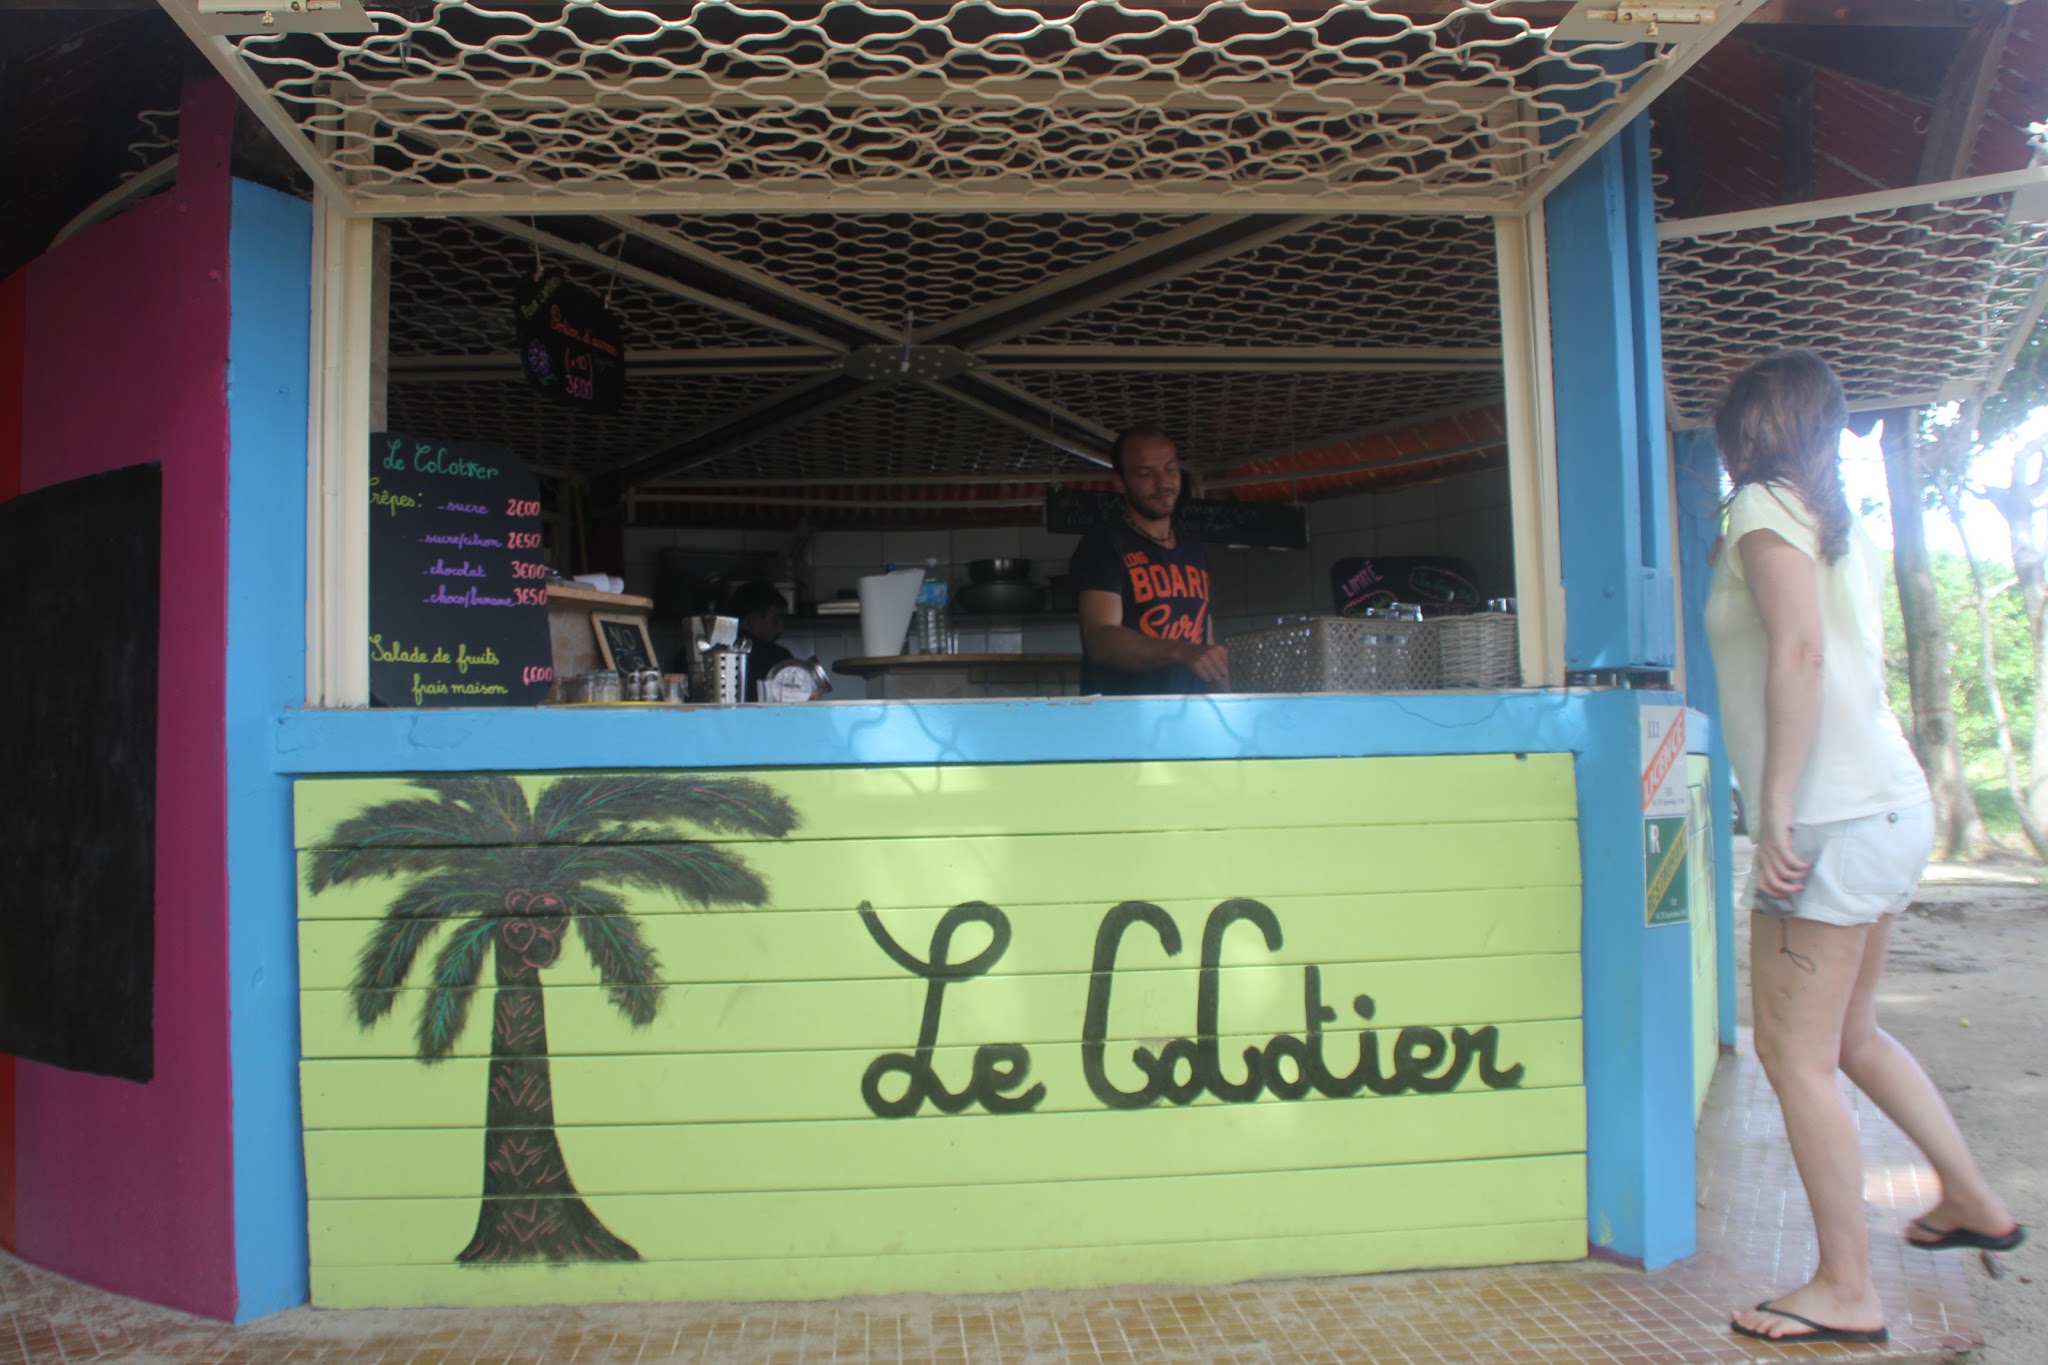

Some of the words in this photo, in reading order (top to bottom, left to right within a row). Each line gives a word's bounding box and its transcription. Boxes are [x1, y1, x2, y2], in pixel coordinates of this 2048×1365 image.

[383, 439, 405, 471] Le
[505, 498, 541, 517] 2€00
[507, 532, 542, 549] 2€50
[511, 560, 546, 579] 3€00
[513, 588, 548, 606] 3€50
[608, 626, 637, 650] NO
[369, 634, 429, 663] Salade
[431, 646, 451, 664] de
[456, 643, 500, 674] fruits
[412, 673, 449, 705] frais
[451, 681, 508, 695] maison
[1645, 714, 1685, 802] LICENCE
[1648, 824, 1661, 854] R
[857, 899, 1047, 1119] Le
